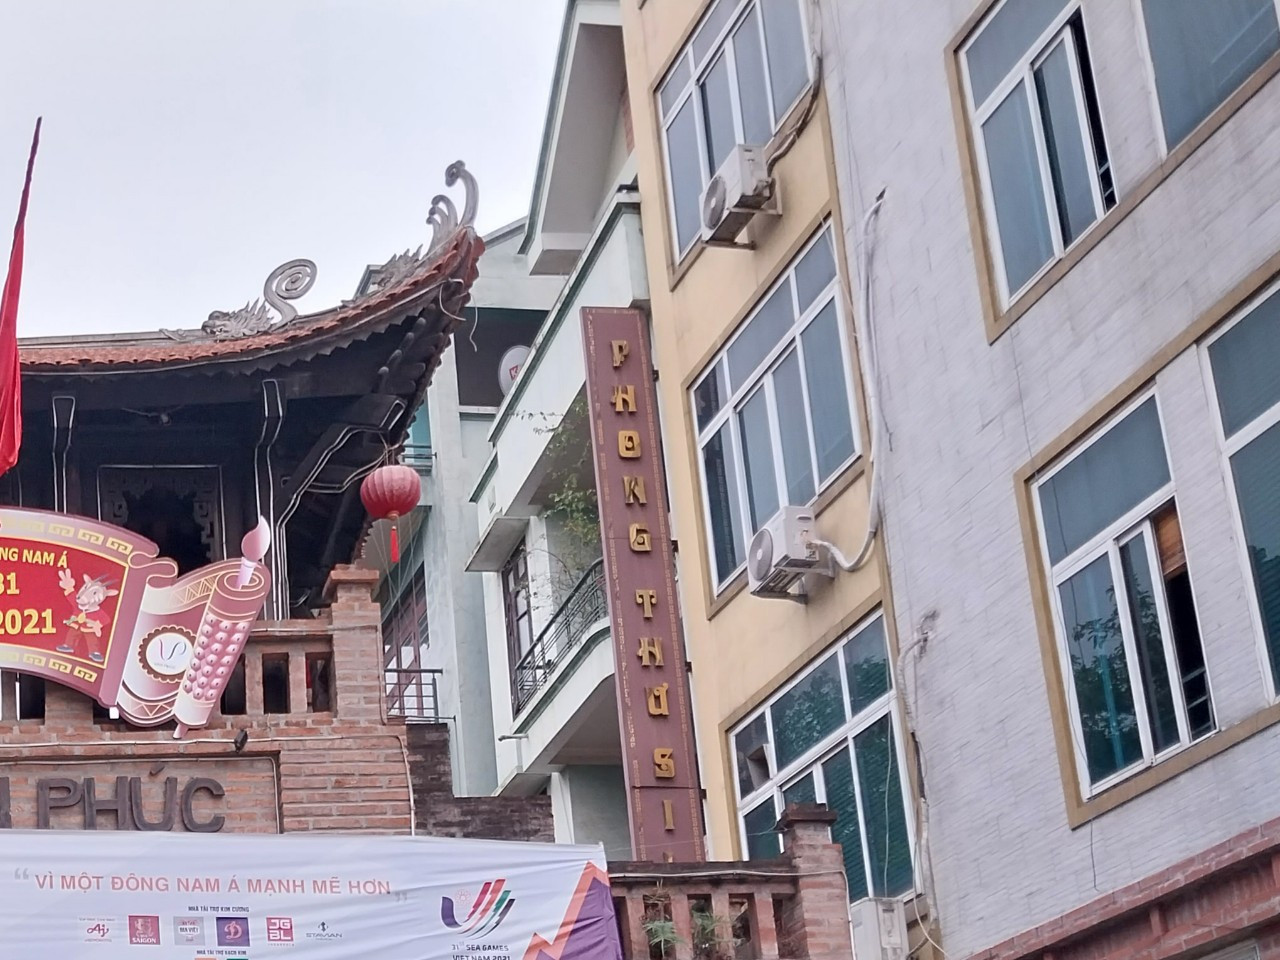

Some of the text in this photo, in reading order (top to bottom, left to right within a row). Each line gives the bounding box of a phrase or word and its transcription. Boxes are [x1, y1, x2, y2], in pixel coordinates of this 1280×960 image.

[22, 548, 54, 566] NAM
[57, 551, 69, 569] Á
[37, 765, 225, 832] PHÚC
[35, 871, 390, 897] VÌ MỘT ĐÔNG NAM Á MẠNH MẼ HƠN
